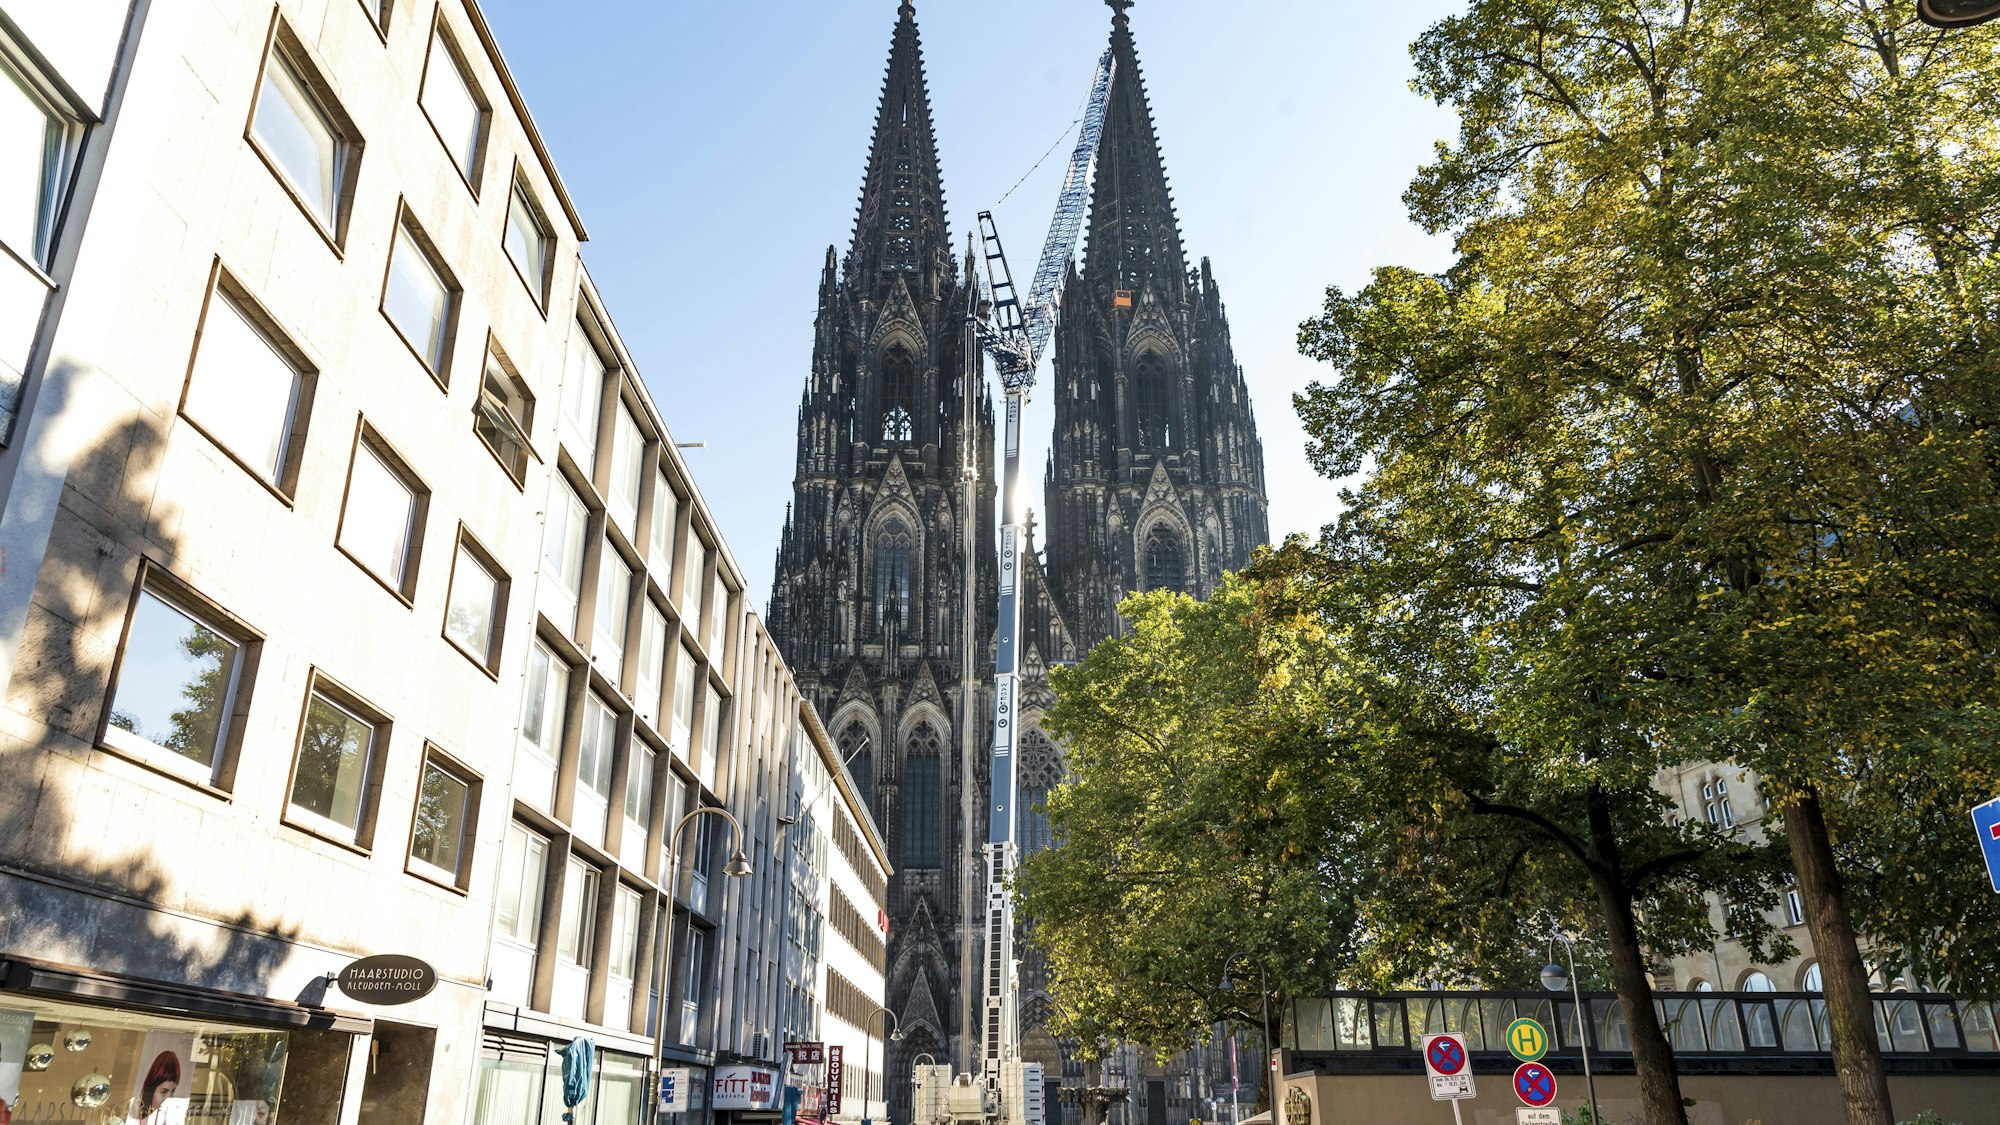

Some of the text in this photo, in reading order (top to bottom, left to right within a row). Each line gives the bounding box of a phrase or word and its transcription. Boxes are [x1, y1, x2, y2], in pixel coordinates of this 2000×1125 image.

[349, 968, 424, 980] HAARSTUDIO
[347, 981, 421, 991] KLEUDGEN-MOLL
[1517, 1028, 1537, 1052] H
[715, 1078, 749, 1093] FITT
[829, 1056, 840, 1113] SOUVENIRS
